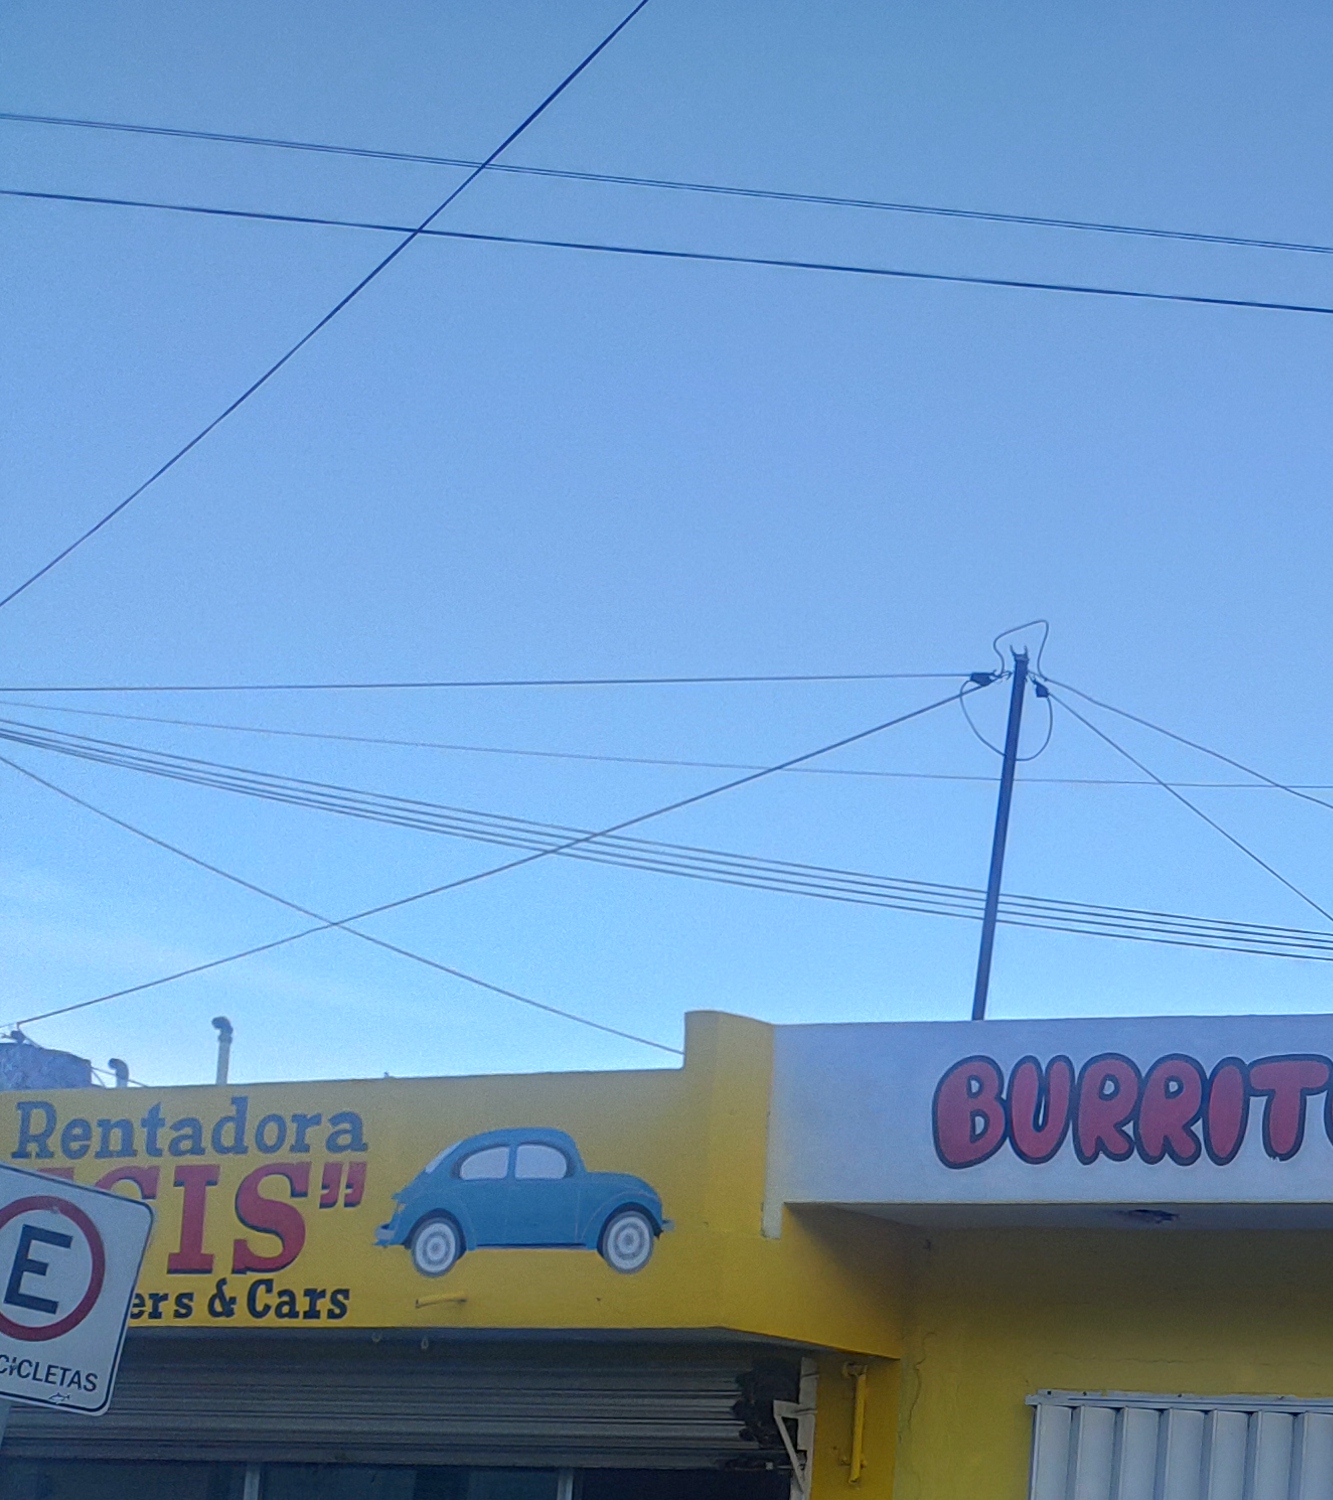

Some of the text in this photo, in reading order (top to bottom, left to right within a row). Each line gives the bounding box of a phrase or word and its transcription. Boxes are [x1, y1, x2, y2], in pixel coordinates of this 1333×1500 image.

[11, 1094, 368, 1160] Rentadora
[2, 1222, 74, 1316] E
[207, 1277, 238, 1320] &
[247, 1277, 350, 1321] Cars
